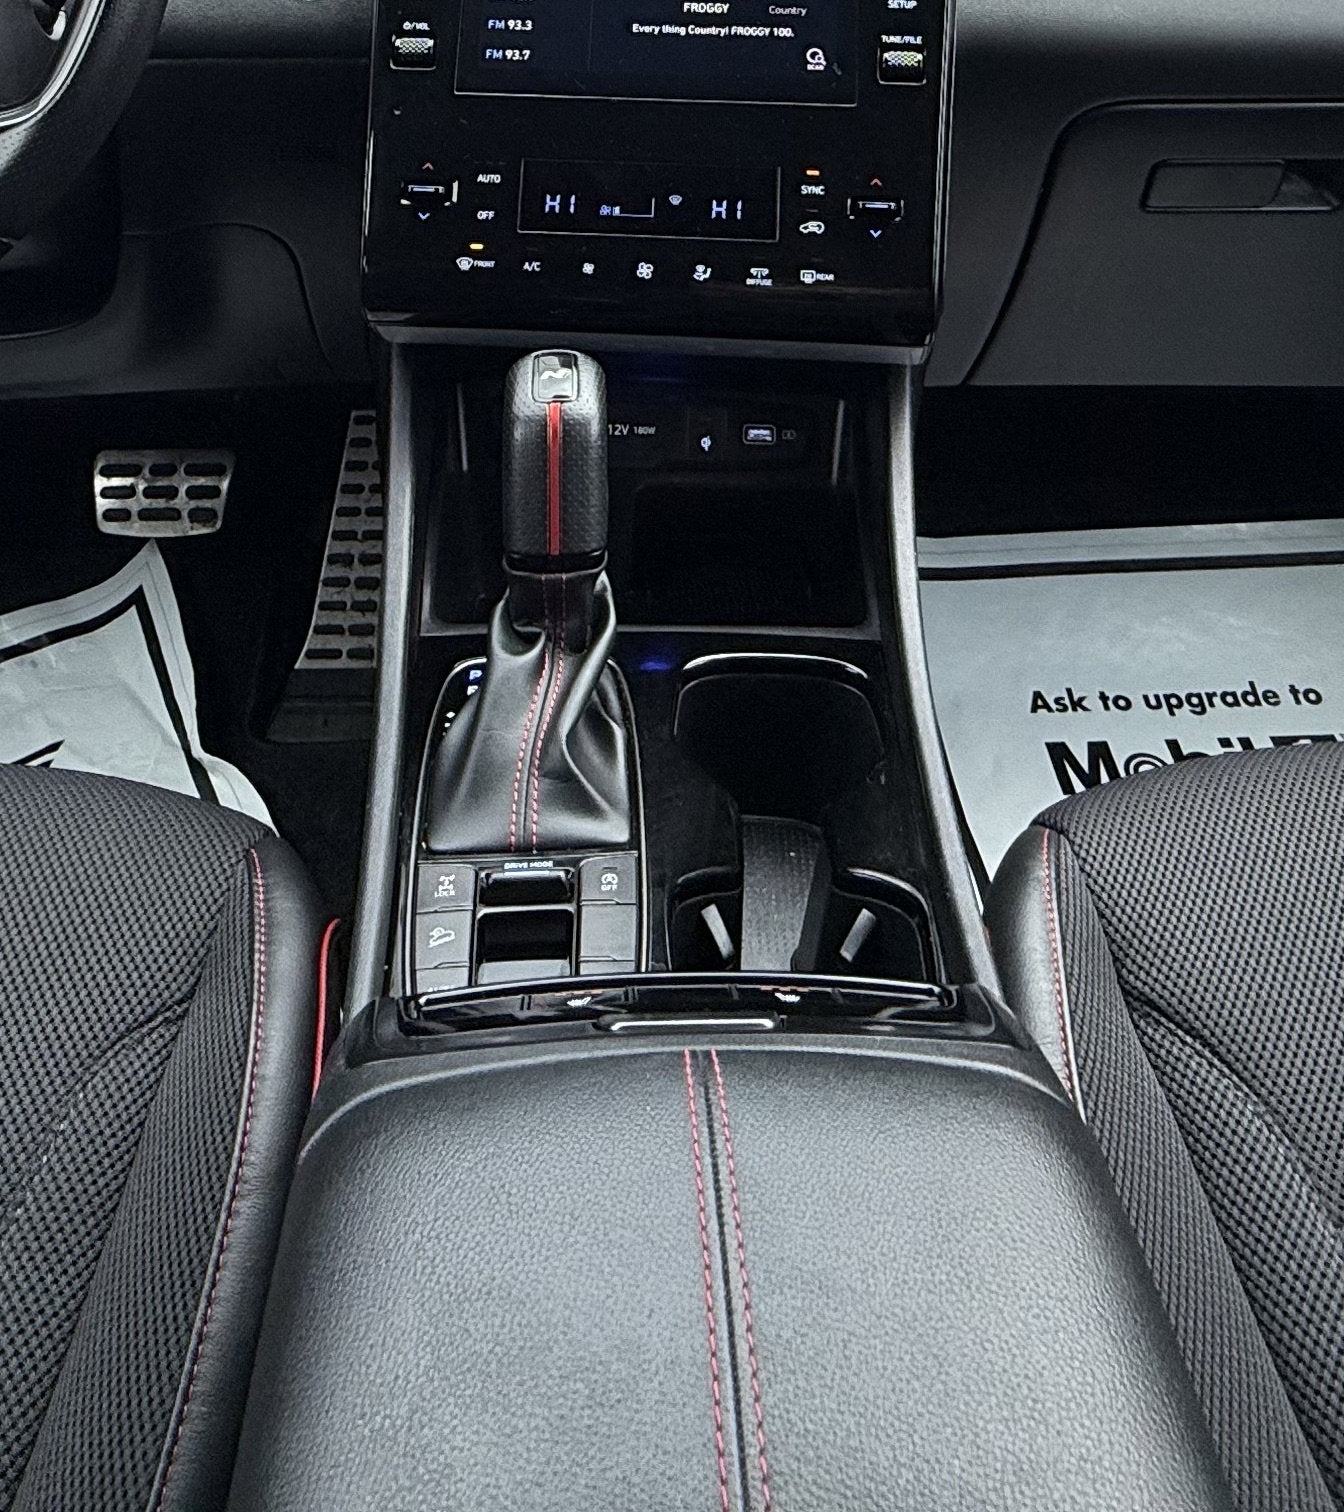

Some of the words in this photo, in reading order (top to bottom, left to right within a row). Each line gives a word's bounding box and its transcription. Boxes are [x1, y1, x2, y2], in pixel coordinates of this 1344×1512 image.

[683, 2, 730, 14] FROGGY
[887, 0, 918, 9] SETUP
[768, 5, 807, 17] Country
[487, 19, 505, 30] FM
[507, 19, 534, 31] 93.3
[632, 23, 661, 36] Every
[662, 24, 687, 36] thing
[731, 26, 771, 37] FROGGY
[485, 49, 503, 59] FM
[504, 49, 531, 60] 93.7
[476, 174, 502, 184] AUTO
[801, 185, 826, 196] SYNC
[476, 210, 496, 221] OFF
[473, 260, 496, 268] FRONT
[522, 261, 542, 272] A/C
[816, 272, 835, 281] REAR
[608, 424, 630, 436] 12V
[1029, 687, 1092, 715] Ask
[1097, 690, 1134, 712] to
[1141, 680, 1283, 717] upgrade
[1287, 683, 1324, 706] to
